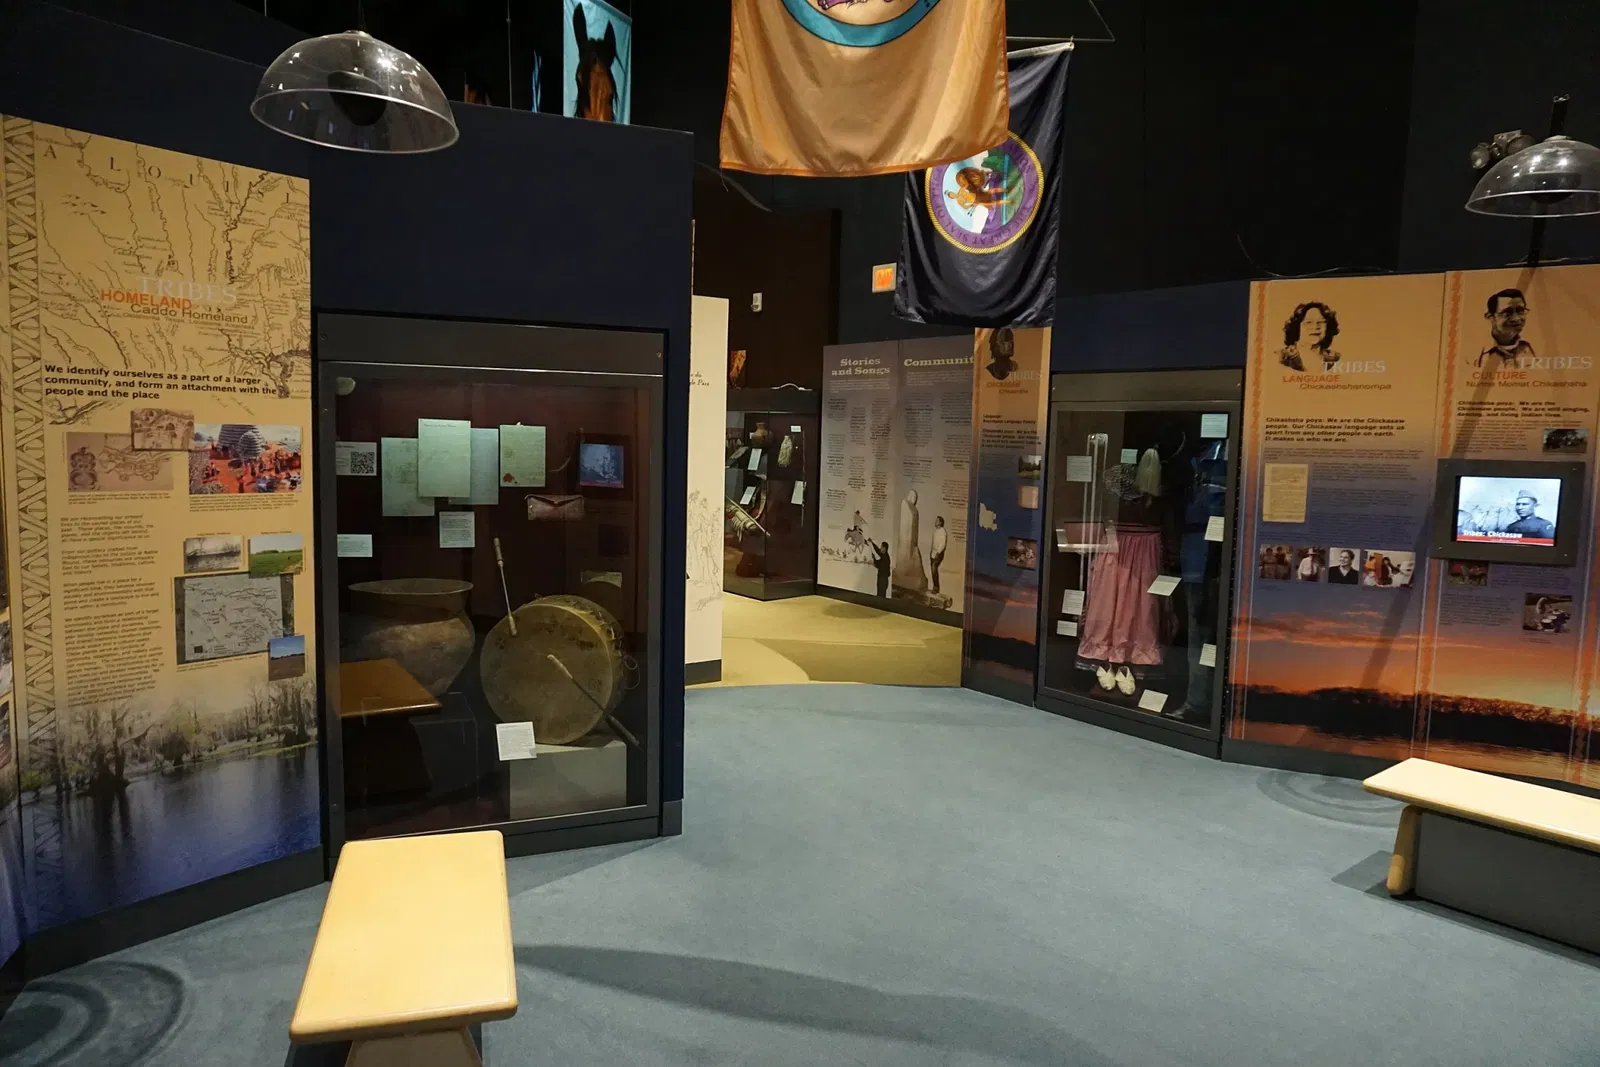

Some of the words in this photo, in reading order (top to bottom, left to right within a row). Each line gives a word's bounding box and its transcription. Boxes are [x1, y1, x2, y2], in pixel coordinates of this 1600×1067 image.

[138, 275, 237, 304] TRIBES
[100, 288, 192, 310] HOMELAND
[130, 303, 178, 317] Caddo
[182, 309, 248, 324] Homeland
[840, 357, 881, 366] Stories
[904, 356, 974, 366] Communit
[1322, 360, 1387, 373] TRIBES
[1517, 356, 1592, 370] TRIBES
[44, 364, 64, 374] We
[66, 366, 110, 378] identify
[113, 370, 164, 379] ourselves
[190, 374, 210, 382] part
[234, 376, 262, 386] larger
[831, 368, 852, 376] and
[854, 366, 890, 376] Songs
[1472, 371, 1528, 380] CULTURE
[1282, 374, 1341, 383] LANGUAGE
[44, 376, 112, 388] community,
[115, 380, 135, 388] and
[138, 381, 163, 389] form
[181, 383, 236, 392] attachment
[239, 386, 260, 394] with
[262, 387, 277, 395] the
[45, 388, 84, 396] people
[87, 389, 108, 397] and
[112, 390, 129, 398] the
[132, 390, 160, 400] place
